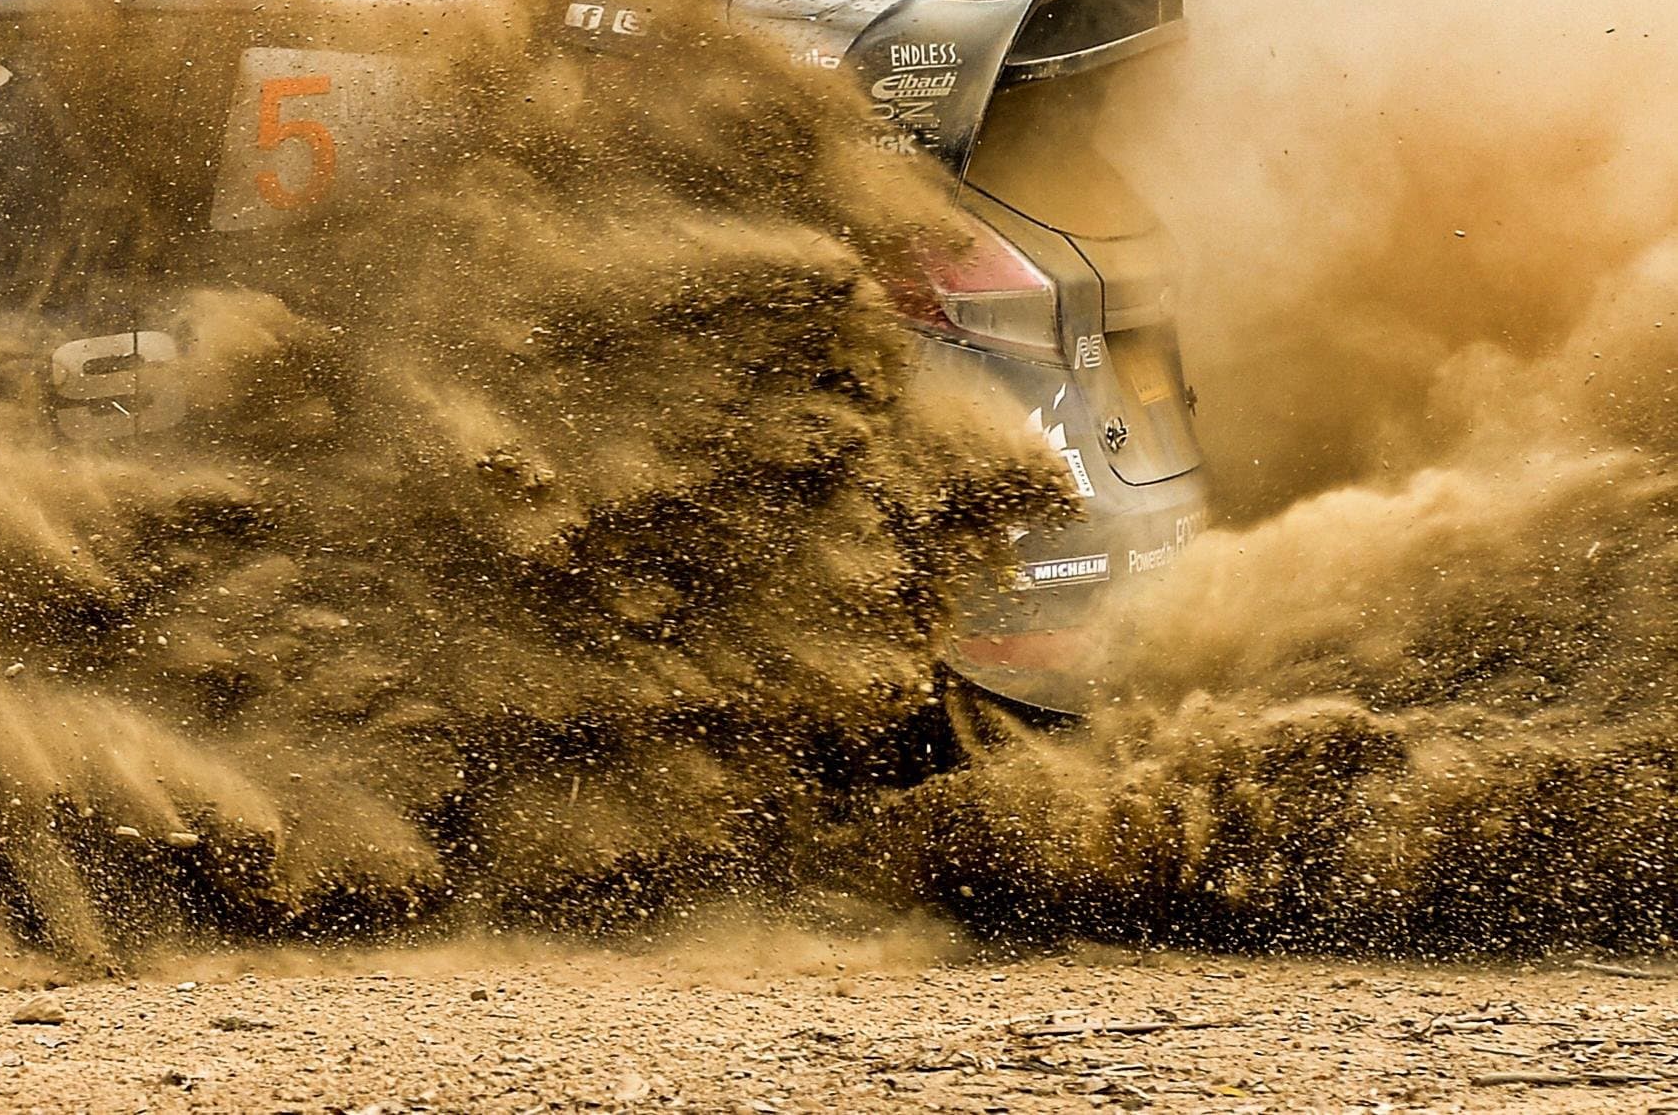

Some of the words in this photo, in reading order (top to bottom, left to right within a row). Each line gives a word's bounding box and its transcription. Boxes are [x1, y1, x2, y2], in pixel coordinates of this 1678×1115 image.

[890, 43, 957, 67] ENDLESS
[871, 72, 957, 100] Eibach
[253, 76, 336, 210] 5
[1035, 557, 1107, 581] MICHELIN
